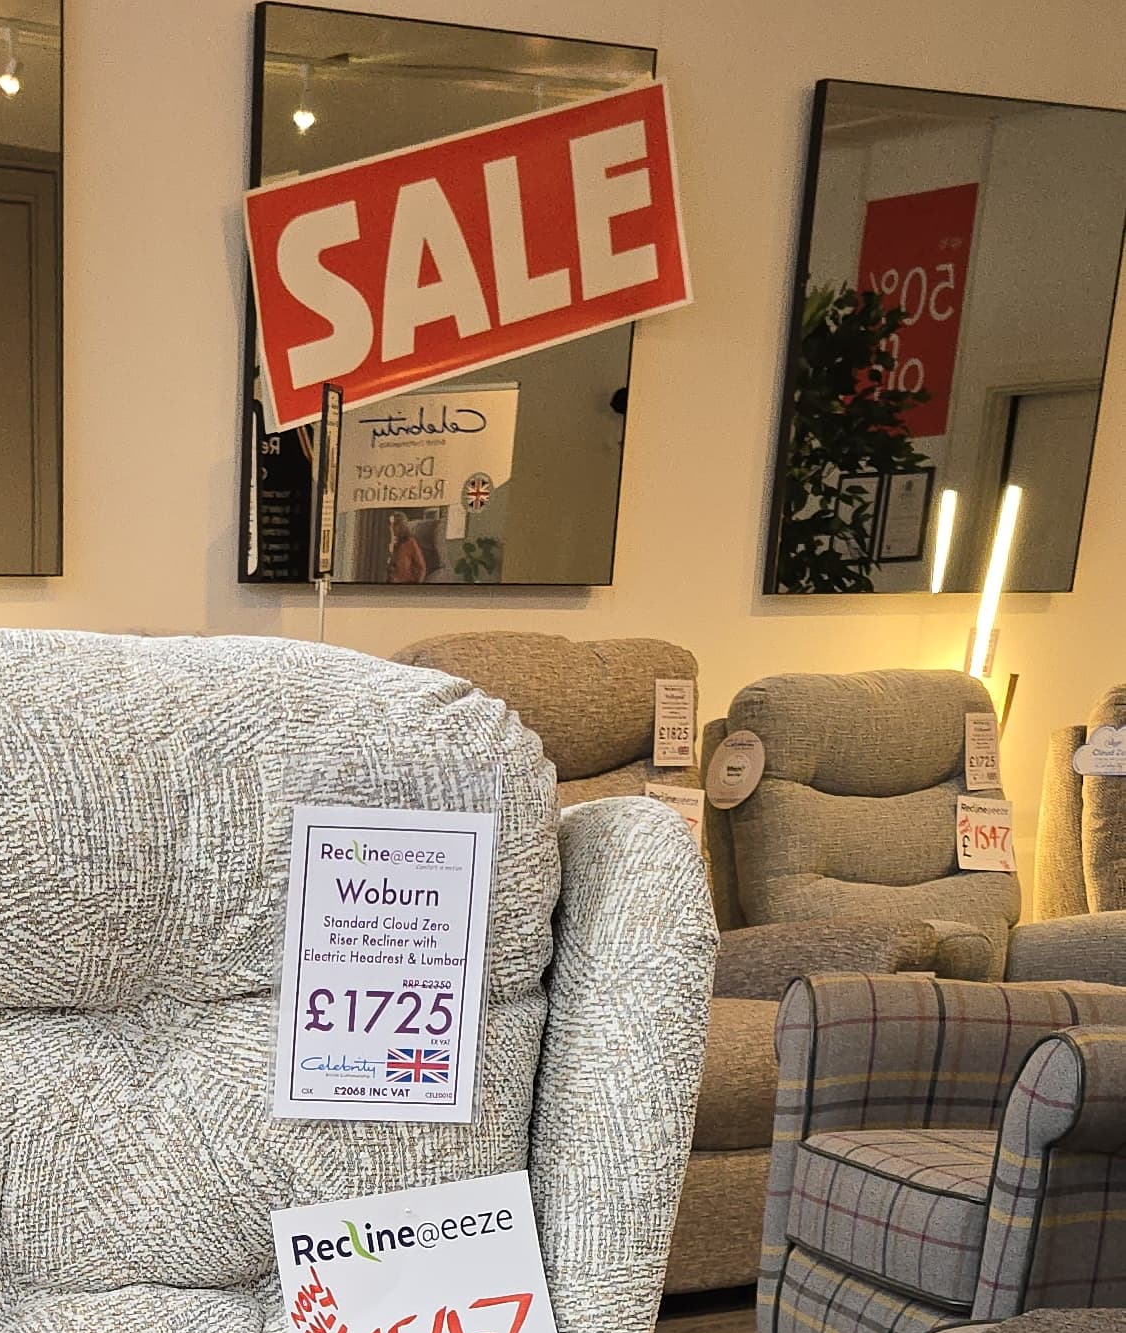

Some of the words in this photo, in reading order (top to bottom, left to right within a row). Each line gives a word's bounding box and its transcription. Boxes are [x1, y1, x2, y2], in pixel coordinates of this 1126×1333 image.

[277, 119, 659, 391] SALE
[658, 726, 689, 741] £1825
[969, 755, 996, 768] £1725
[335, 877, 440, 907] Woburn
[323, 915, 379, 930] Standard
[382, 917, 419, 931] Cloud
[421, 919, 450, 932] Zero
[329, 933, 358, 946] Riser
[362, 933, 409, 948] Recliner
[412, 935, 437, 948] with
[303, 949, 347, 963] Electric
[349, 950, 405, 965] Headrest
[407, 952, 417, 965] &
[420, 951, 466, 967] Lumbar
[402, 979, 420, 989] RRP
[304, 987, 454, 1036] £1725
[300, 1055, 386, 1079] Celebrity
[333, 1086, 366, 1096] £2068
[368, 1087, 389, 1097] INC
[390, 1088, 411, 1097] VAT
[291, 1265, 324, 1330] NOW
